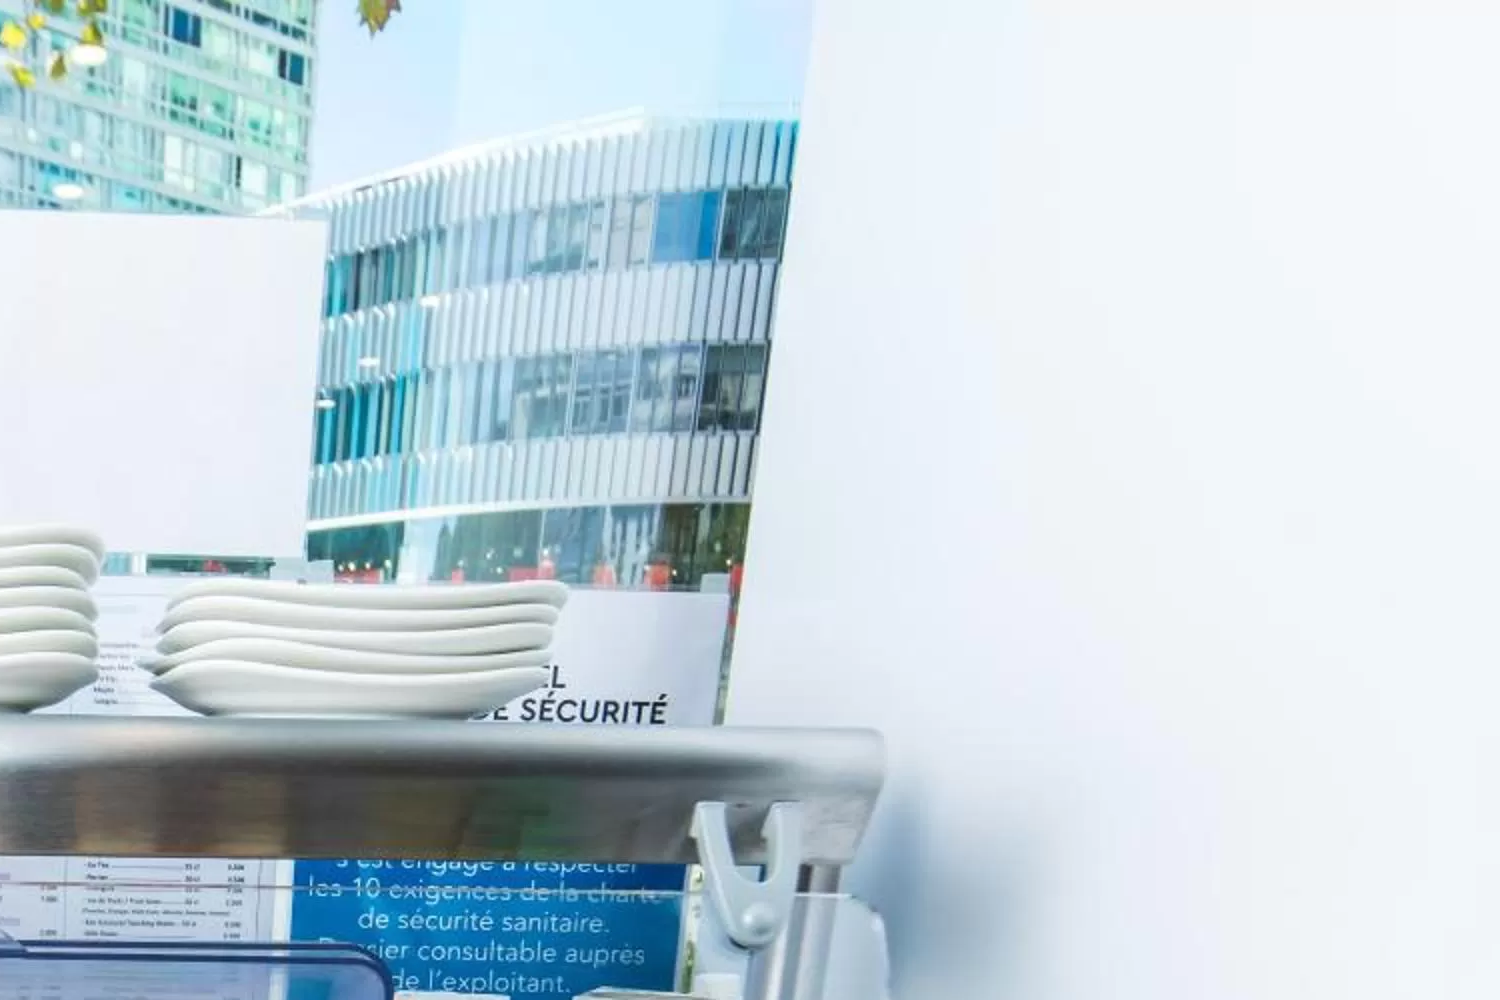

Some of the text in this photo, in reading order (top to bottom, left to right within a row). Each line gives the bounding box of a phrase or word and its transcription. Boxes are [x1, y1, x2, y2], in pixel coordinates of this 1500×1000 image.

[520, 691, 668, 725] SÉCURITÉ
[309, 876, 342, 897] les
[354, 877, 381, 898] 10
[389, 878, 510, 905] exigences
[520, 879, 549, 901] de
[560, 880, 579, 902] la
[357, 906, 610, 933] de sécurité sanitaire.
[417, 939, 557, 963] consultable
[565, 943, 645, 969] auprès
[391, 968, 570, 994] de l'exploitant.
